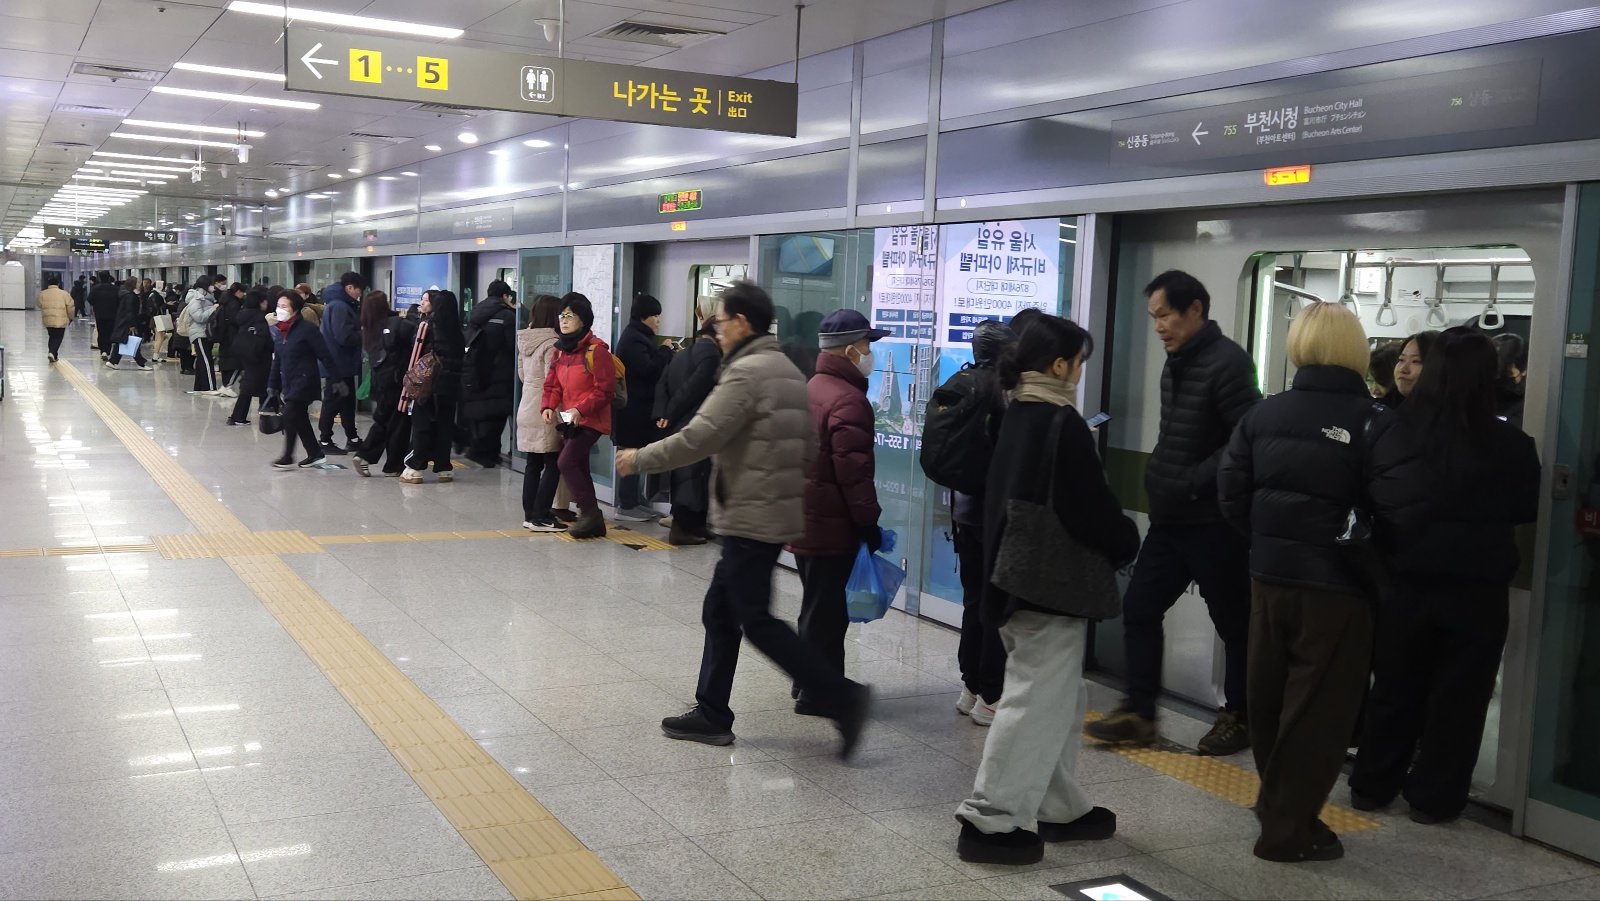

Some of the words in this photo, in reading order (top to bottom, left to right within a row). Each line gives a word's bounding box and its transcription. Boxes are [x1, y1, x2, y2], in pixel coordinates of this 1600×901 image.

[357, 55, 370, 78] 1
[424, 62, 440, 84] 5
[613, 79, 682, 112] 나가는
[688, 87, 712, 115] 곳
[728, 90, 753, 104] Exit
[1450, 96, 1463, 106] 756
[727, 107, 747, 118] 出口
[1303, 104, 1334, 115] Bucheon
[1334, 101, 1349, 111] City
[1348, 98, 1363, 109] Hall
[1244, 106, 1299, 133] 부천시청
[1223, 125, 1238, 136] 755
[1302, 129, 1330, 140] (Bucheon
[1330, 127, 1342, 136] Arts
[1341, 124, 1363, 135] Center)
[1127, 134, 1149, 149] 신중동
[1256, 131, 1296, 146] (부천아트센터)
